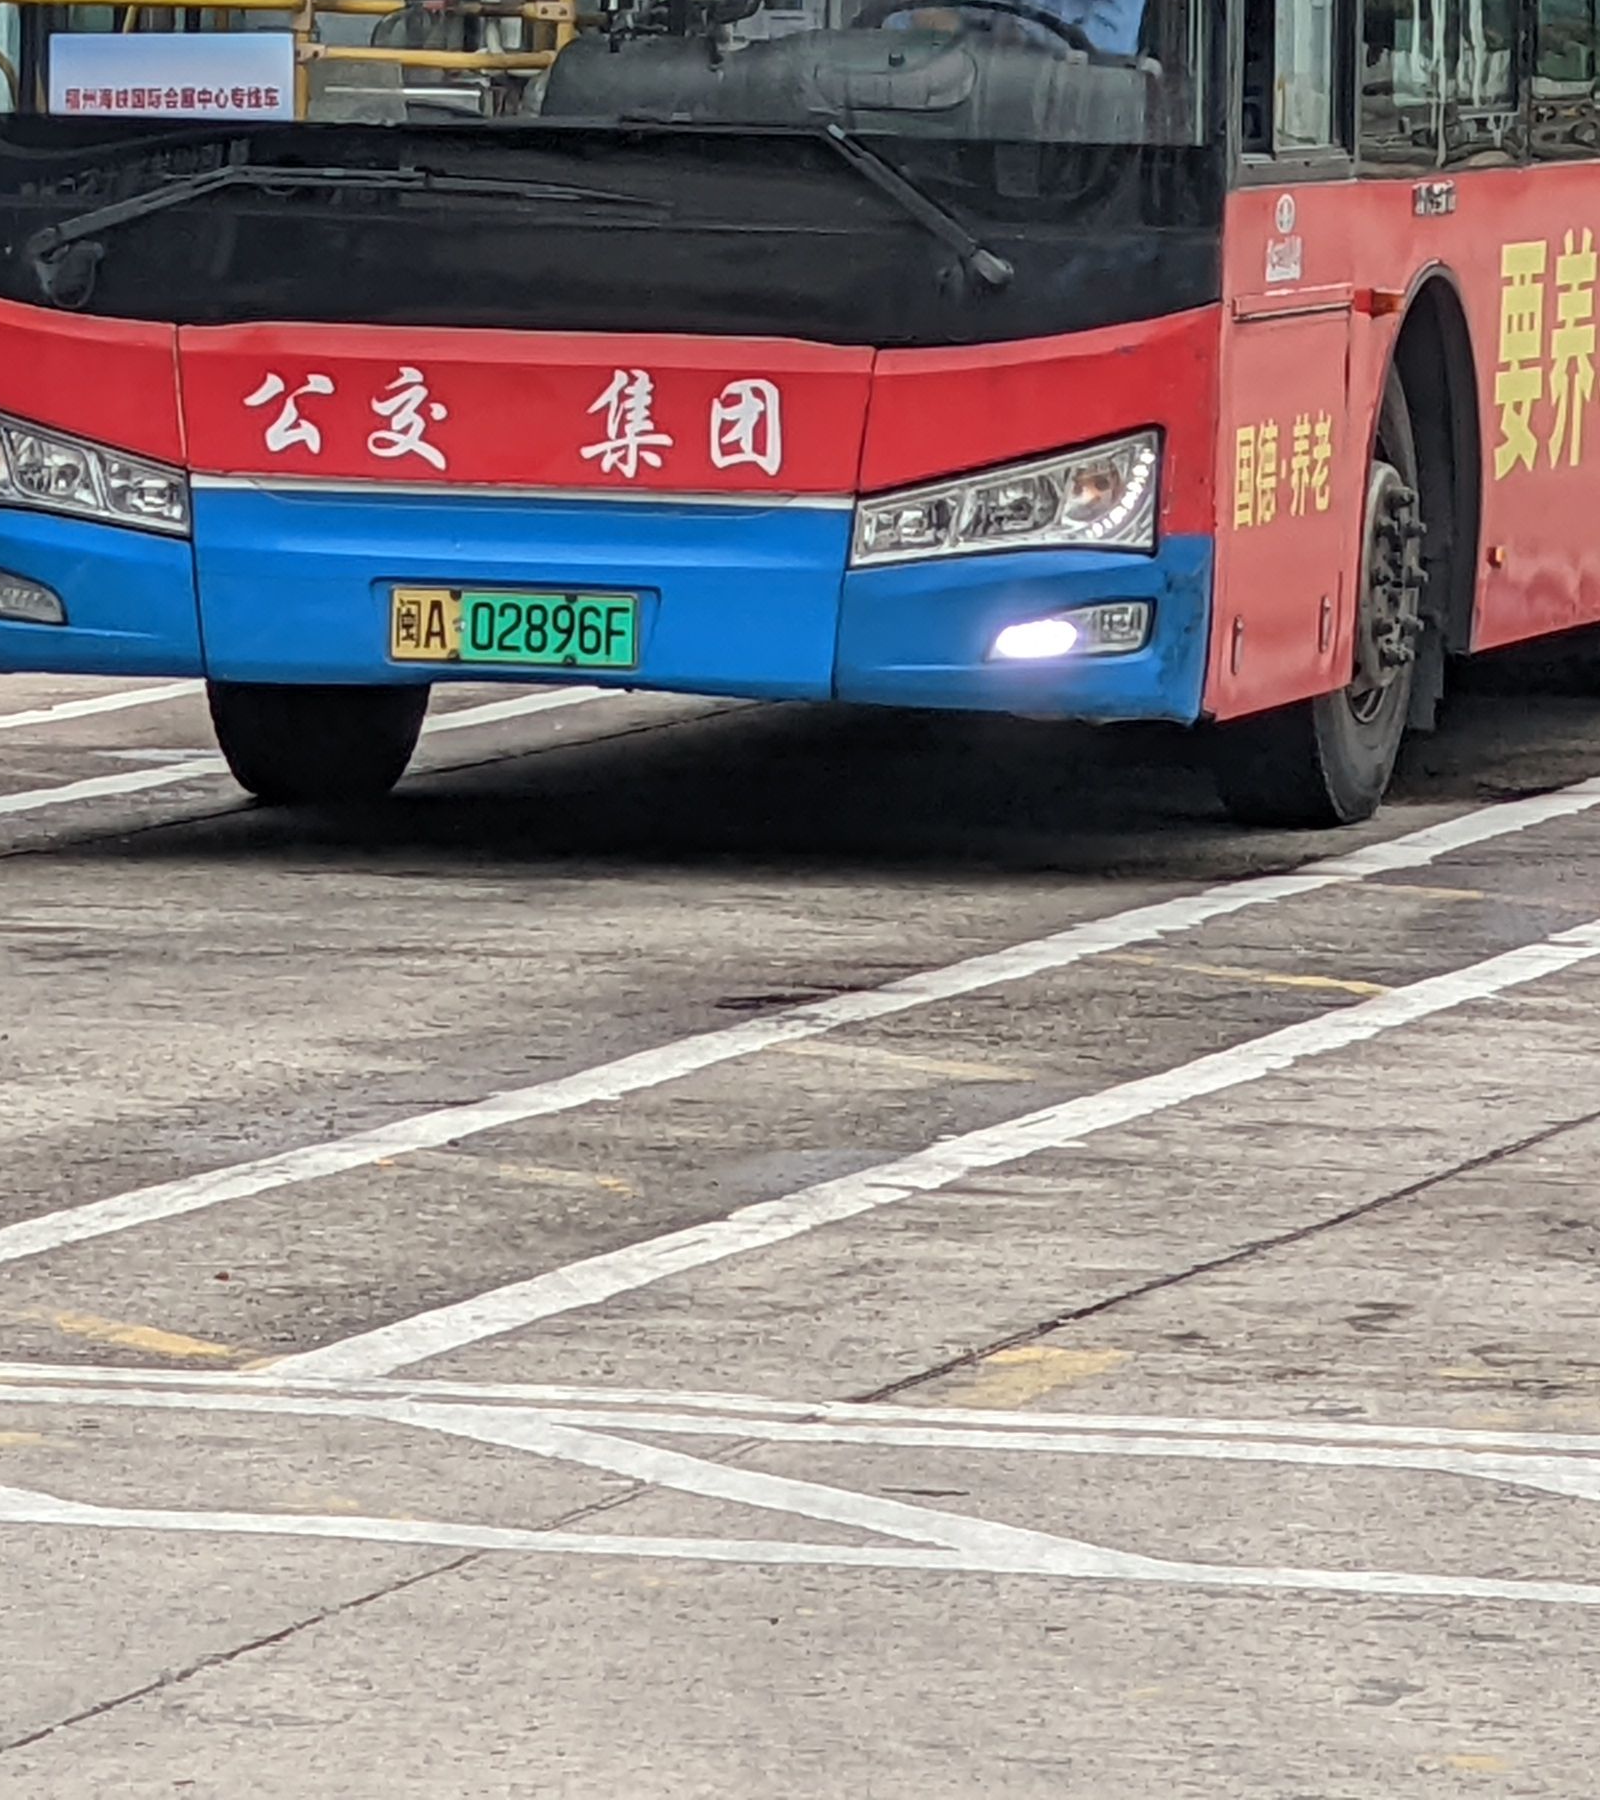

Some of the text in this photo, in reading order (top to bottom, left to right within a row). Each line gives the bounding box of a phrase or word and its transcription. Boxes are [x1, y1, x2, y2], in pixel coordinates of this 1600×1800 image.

[65, 87, 280, 112] 福州海峡国际会展中心专线车
[243, 366, 784, 477] 公交 集团
[396, 598, 631, 657] 闽A 02896F
